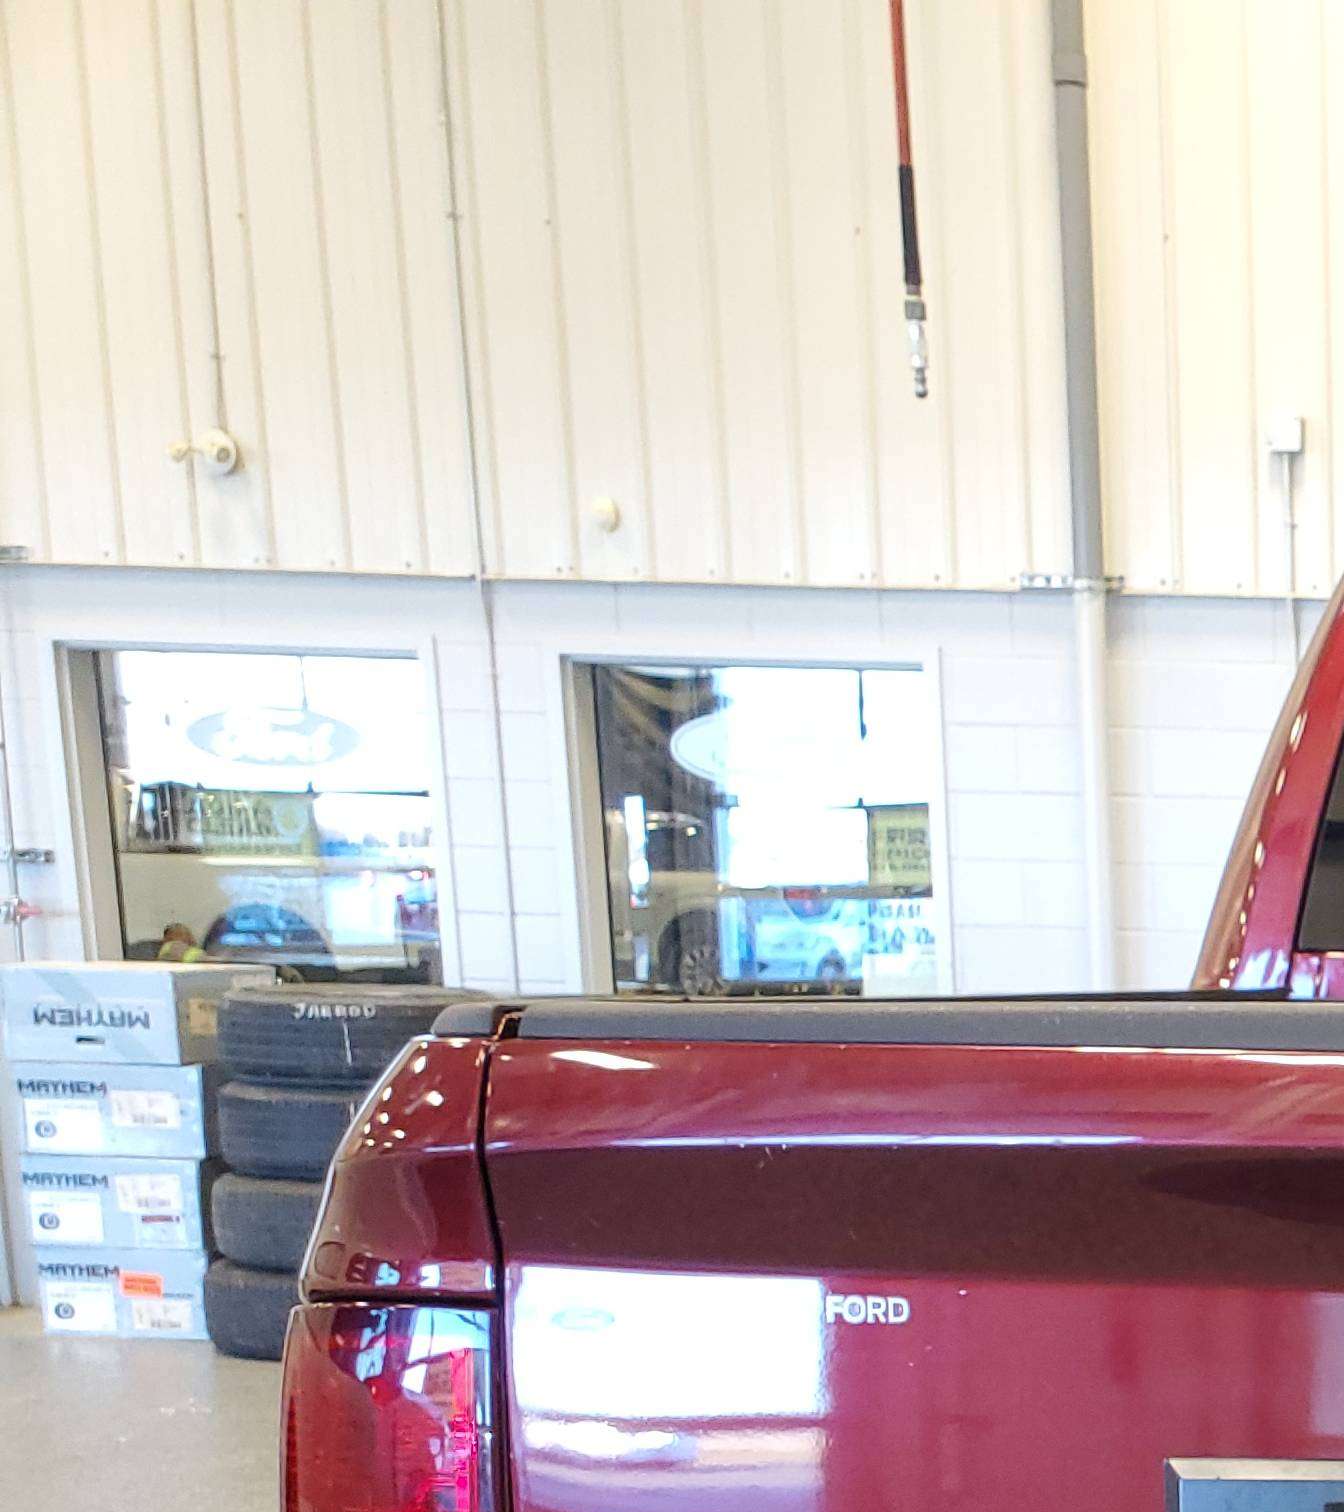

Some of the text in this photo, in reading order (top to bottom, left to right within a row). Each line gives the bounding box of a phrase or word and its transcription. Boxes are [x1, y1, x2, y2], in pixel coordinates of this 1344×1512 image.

[32, 1004, 151, 1028] MAYHEM
[17, 1079, 107, 1095] MAYHEM
[22, 1171, 109, 1189] MAYHEM
[37, 1262, 120, 1280] MAYHEM
[826, 1295, 911, 1324] FORD
